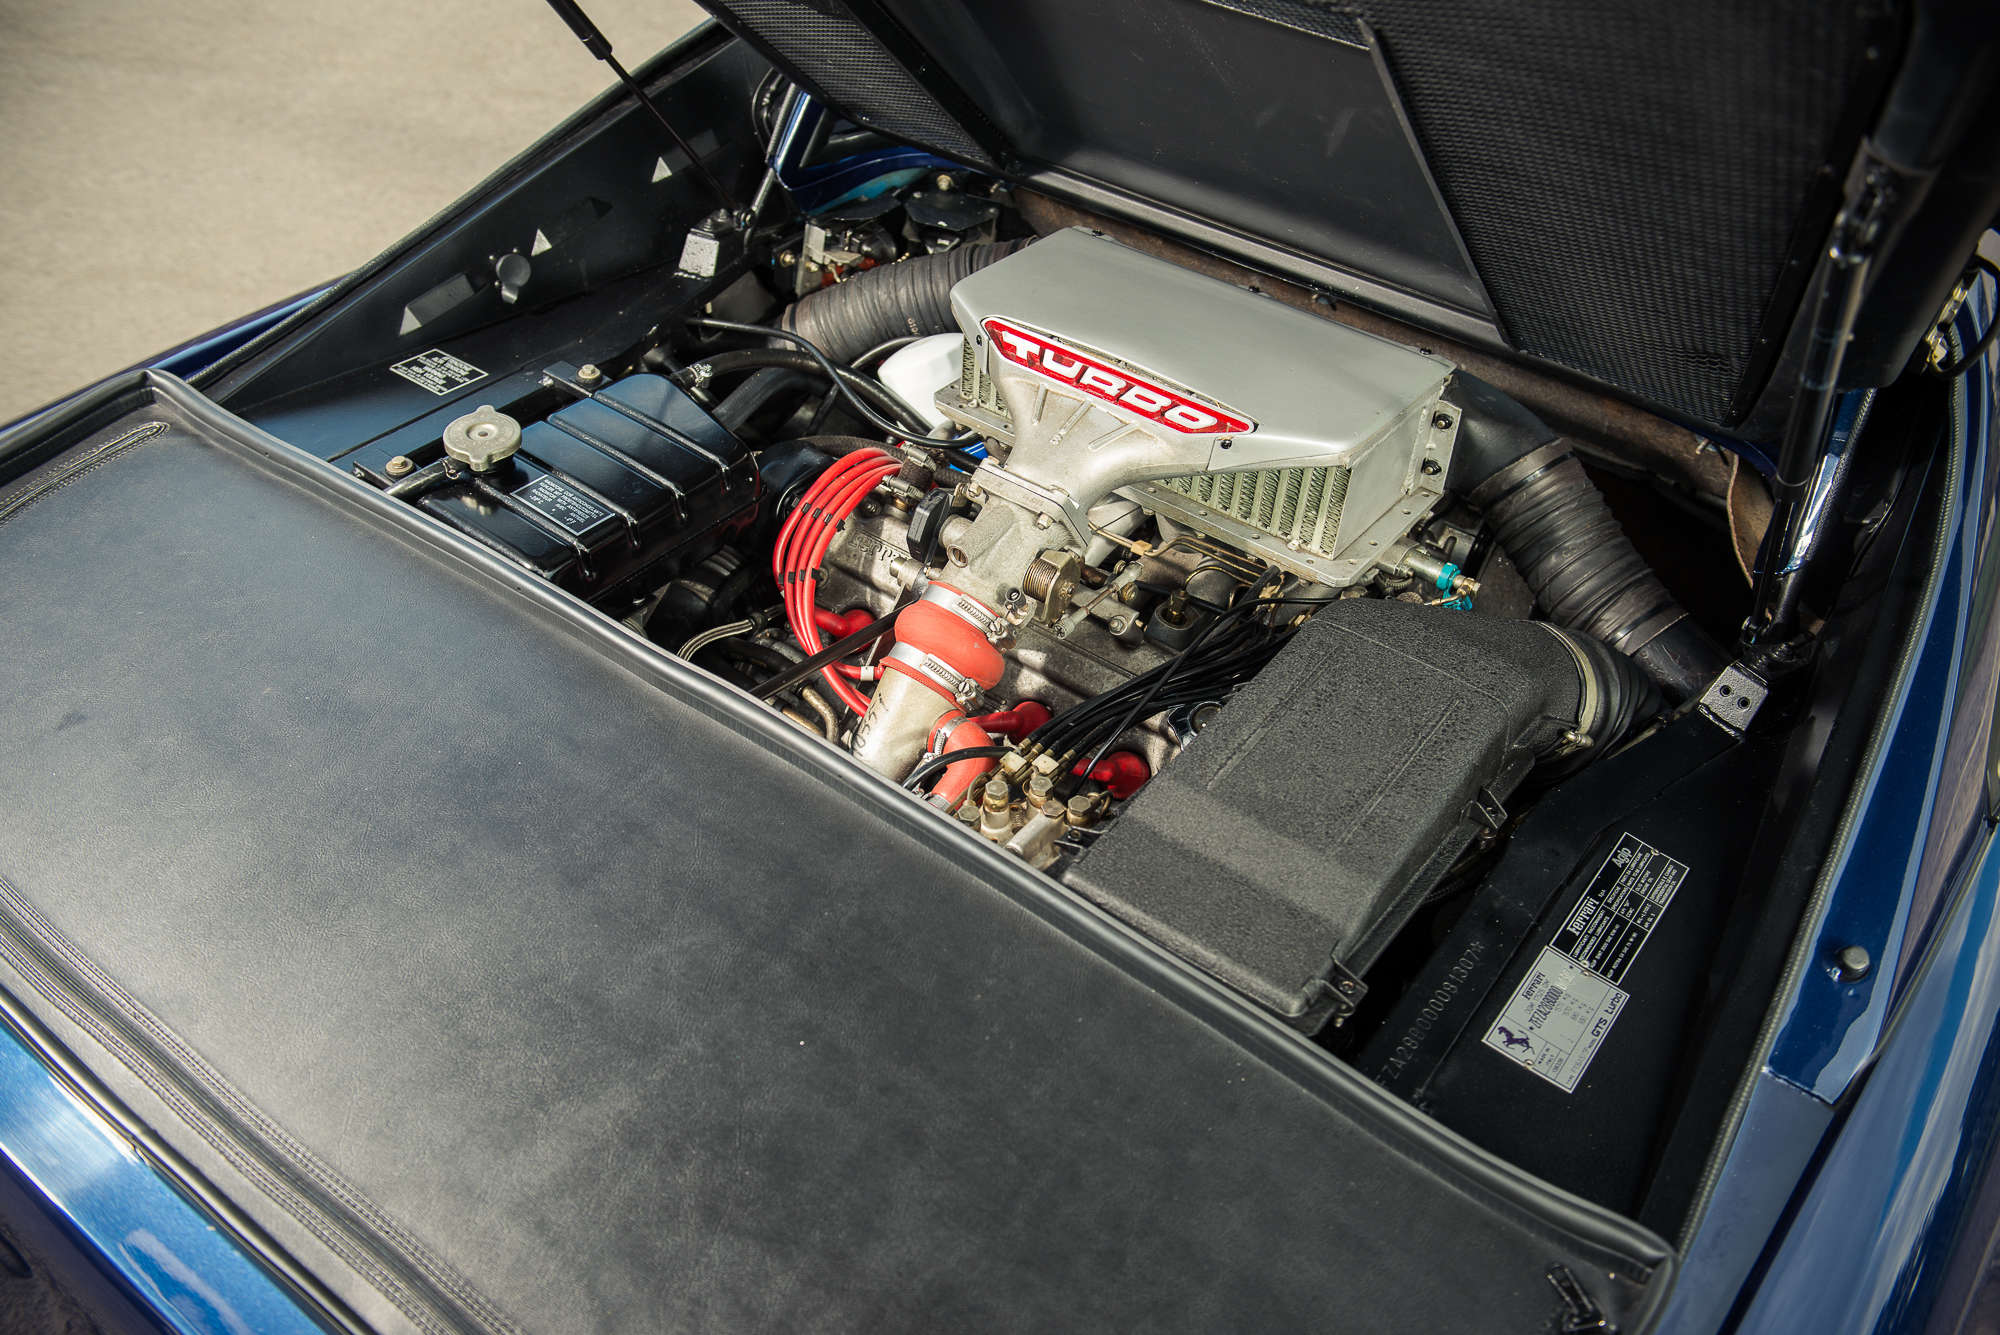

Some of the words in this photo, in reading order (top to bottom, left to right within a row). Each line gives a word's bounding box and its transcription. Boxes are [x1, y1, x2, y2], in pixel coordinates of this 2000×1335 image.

[1001, 330, 1218, 429] TURBO
[1567, 897, 1599, 936] Ferrari
[1612, 848, 1632, 868] Agip
[1522, 971, 1545, 1000] Ferrari
[1591, 1017, 1607, 1037] GTS
[1604, 993, 1623, 1014] turbo
